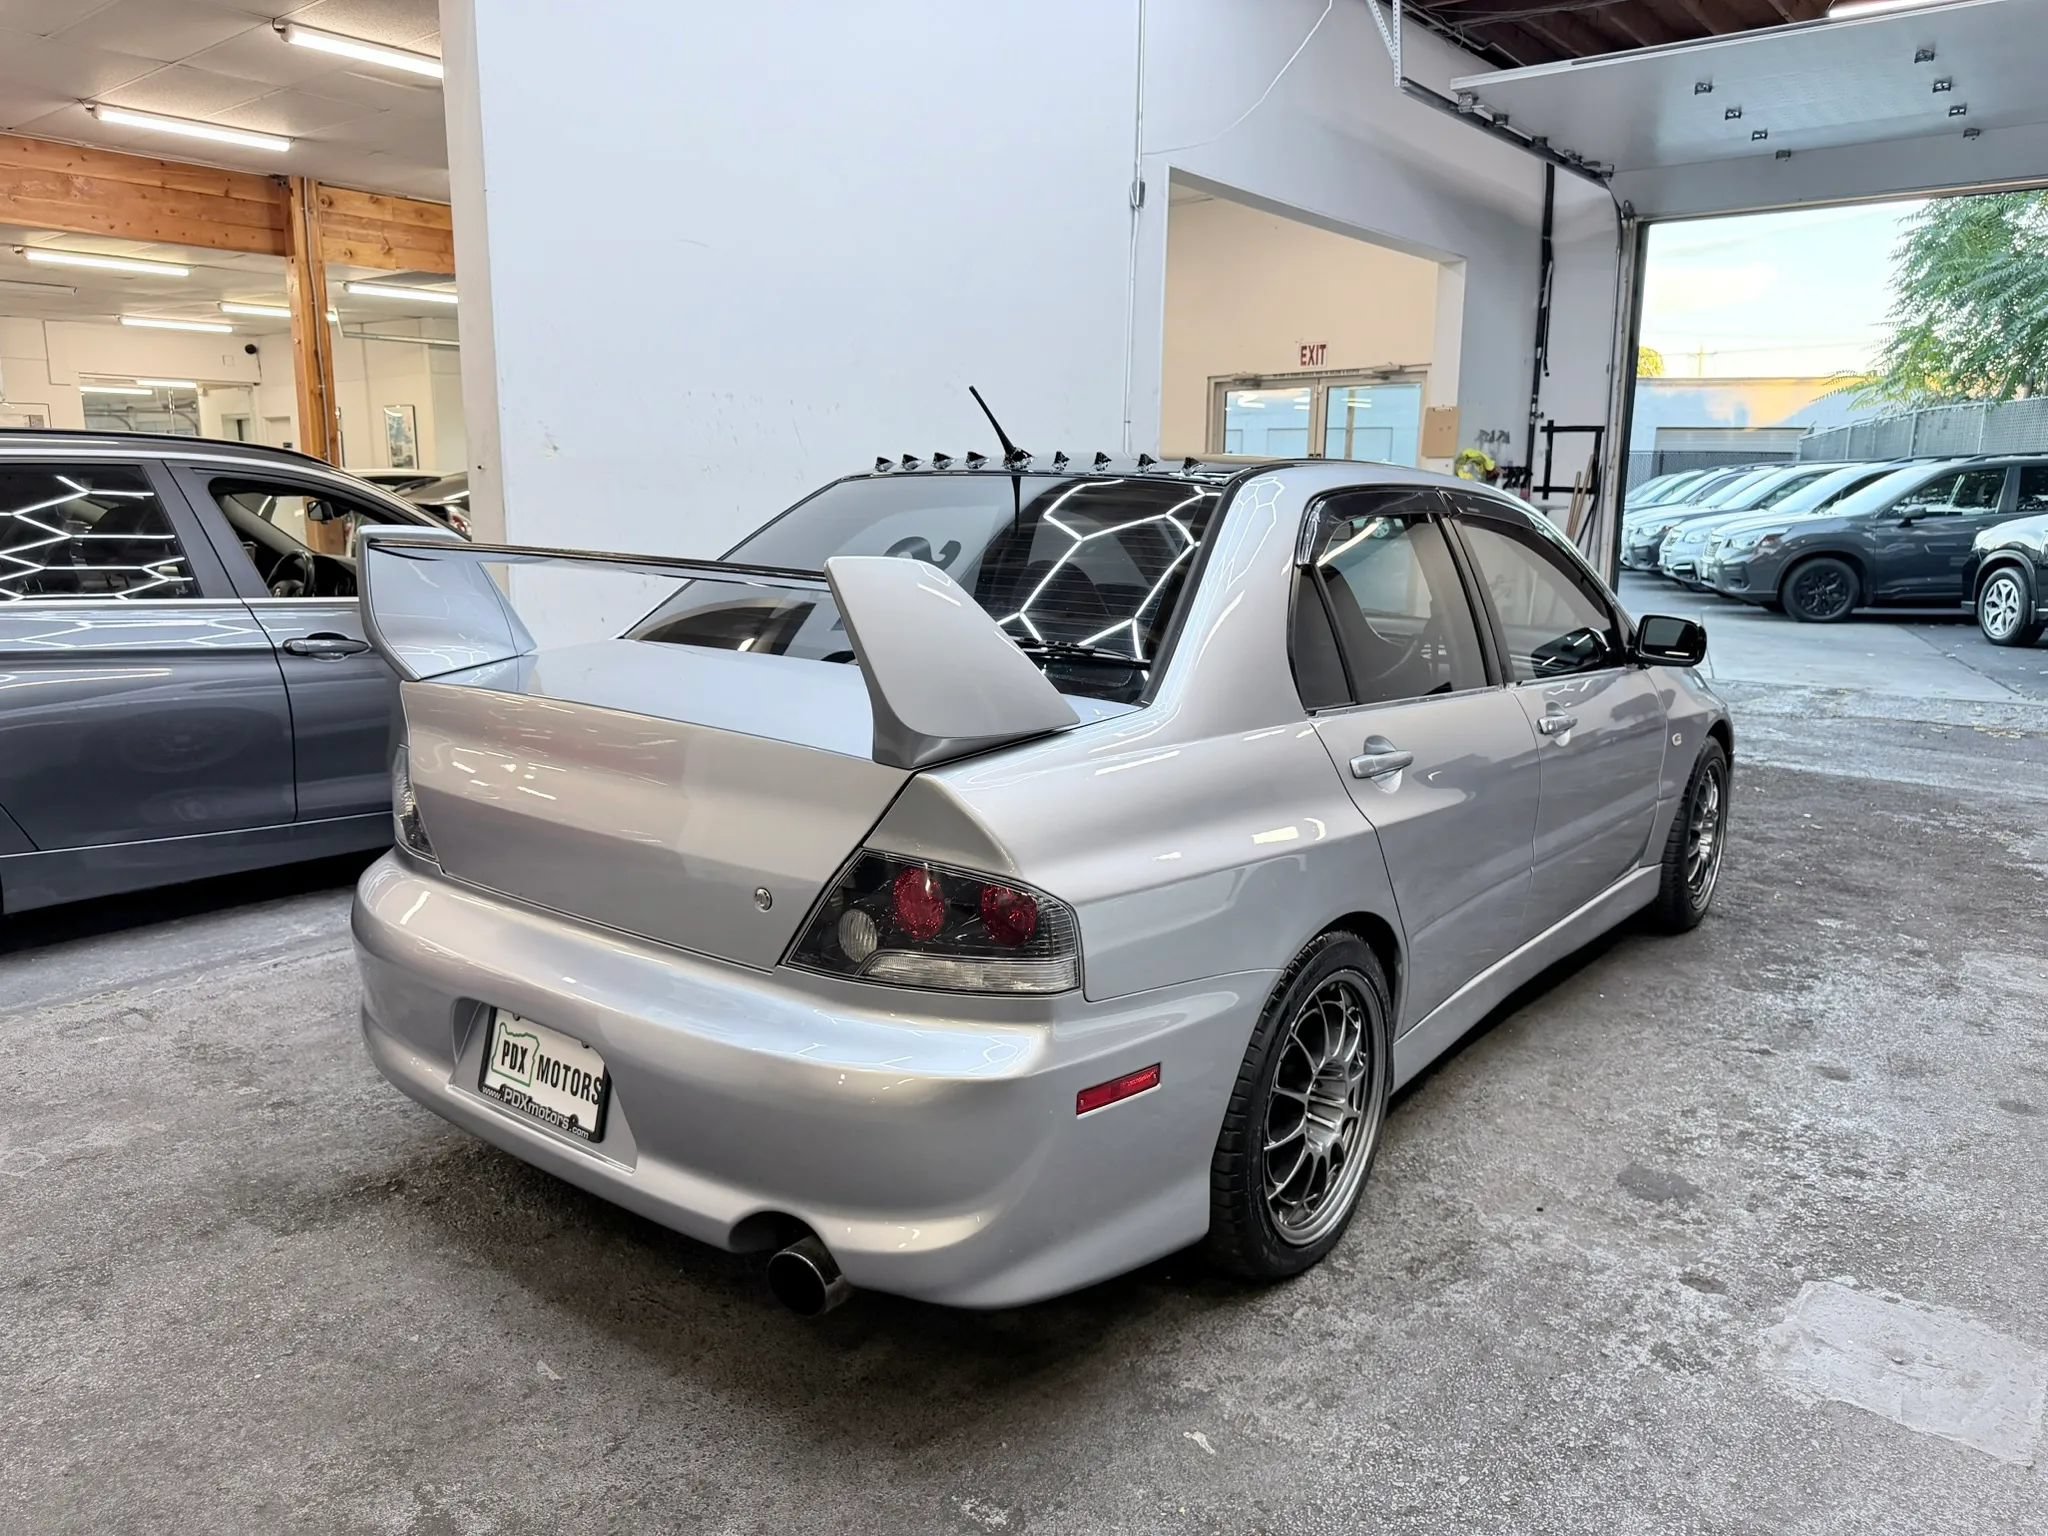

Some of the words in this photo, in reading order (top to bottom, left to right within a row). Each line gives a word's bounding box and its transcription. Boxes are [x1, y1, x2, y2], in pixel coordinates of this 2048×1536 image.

[1300, 344, 1327, 366] EXIT
[501, 1039, 528, 1075] PDX
[536, 1054, 603, 1105] MOTORS
